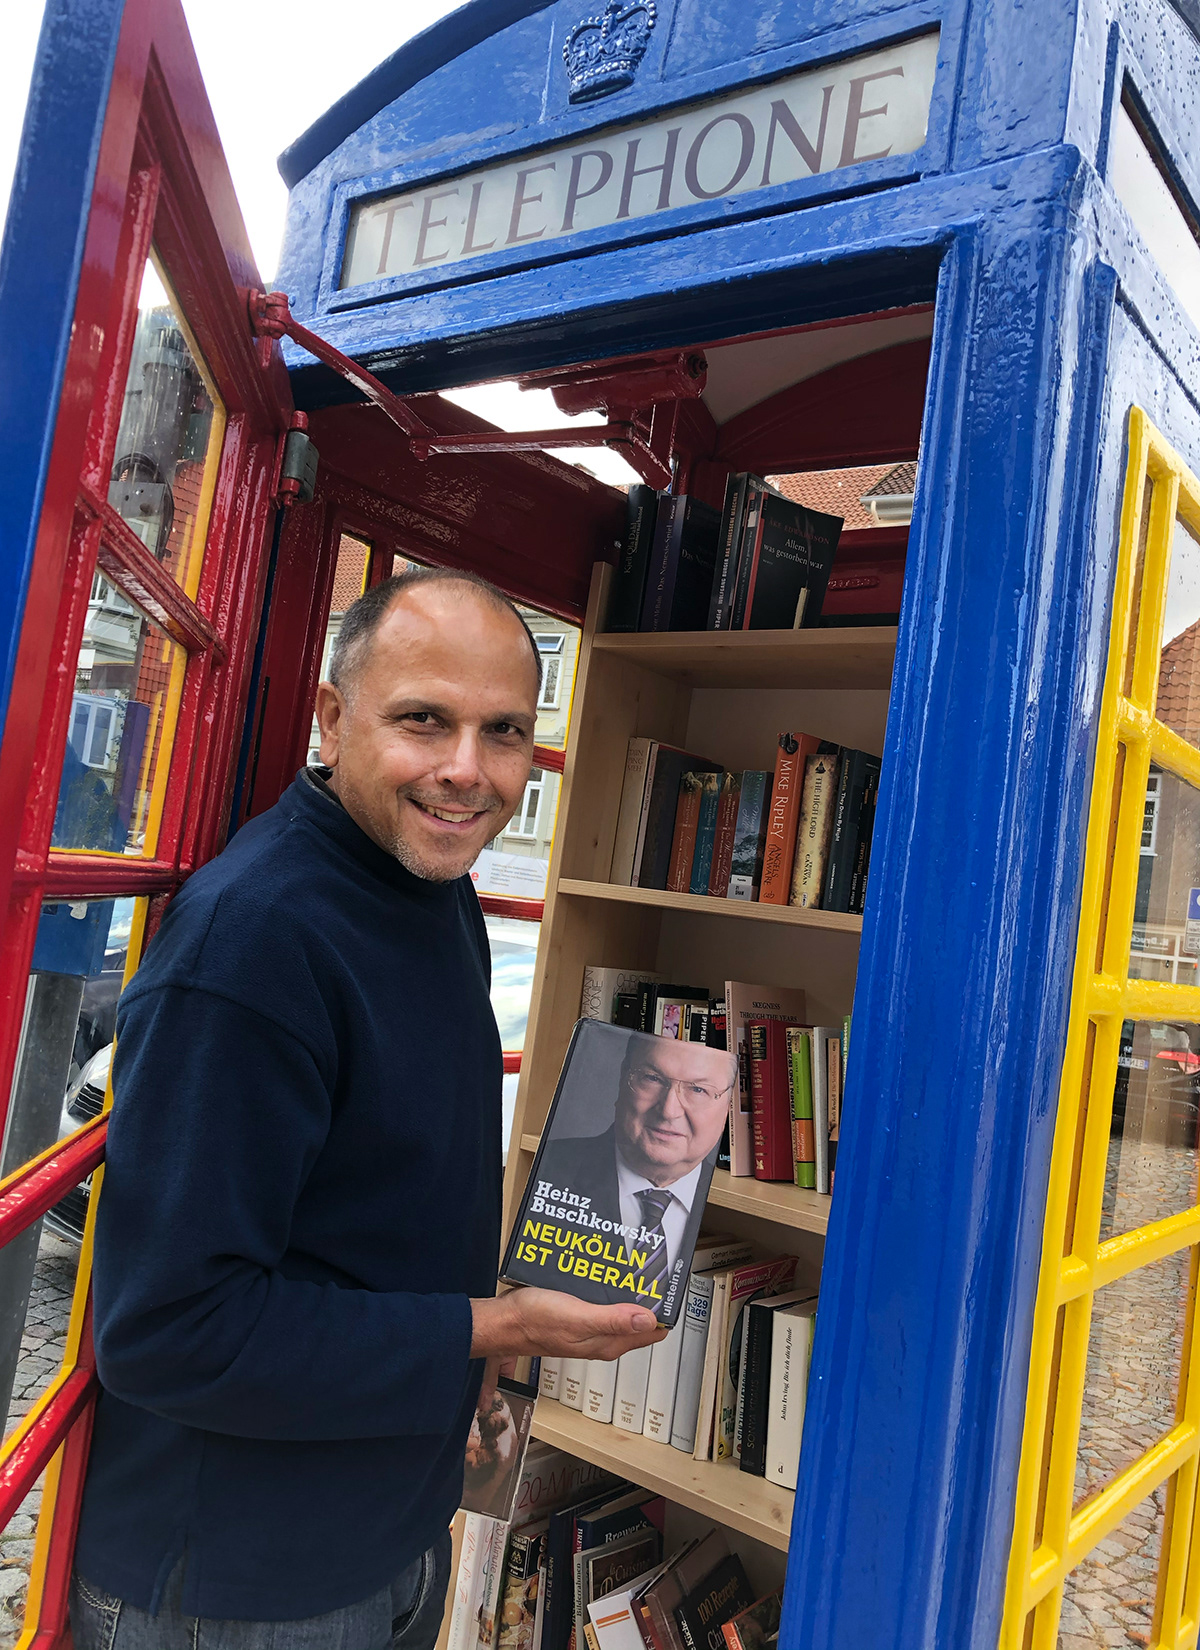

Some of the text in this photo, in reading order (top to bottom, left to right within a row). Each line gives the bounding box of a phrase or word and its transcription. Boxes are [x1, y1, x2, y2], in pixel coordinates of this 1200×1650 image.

[372, 67, 905, 276] TELEPHONE
[763, 543, 775, 556] was
[775, 547, 808, 567] gestorben
[809, 559, 824, 570] war
[785, 537, 807, 554] Allem,
[657, 576, 666, 592] Das
[714, 609, 722, 629] PIPER
[768, 758, 793, 840] MIKE RIPLEY
[811, 793, 821, 816] HIGH
[808, 815, 818, 839] LORD
[763, 843, 776, 886] UNAWARE
[771, 843, 782, 879] ANGELS
[802, 853, 811, 886] CANAVAN
[640, 992, 648, 1017] Canem
[739, 1011, 798, 1023] THROUGH THE YEARS
[752, 1001, 781, 1010] SKEGNESS
[700, 1016, 708, 1042] PIPER
[534, 1180, 592, 1209] Heinz
[530, 1196, 665, 1250] Buschkowsky
[522, 1219, 647, 1270] NEUKÖLLN
[516, 1241, 663, 1300] IST ÜBERALL
[663, 1274, 680, 1317] ullstein
[687, 1302, 707, 1317] Tage
[692, 1297, 708, 1309] 329
[781, 1383, 789, 1404] Irving
[785, 1326, 793, 1345] finde
[745, 1414, 755, 1450] SONYA
[518, 1462, 611, 1509] 20-Minute
[604, 1520, 648, 1544] Brewer's
[483, 1521, 505, 1609] 20-Minute Cookbook
[696, 1575, 741, 1626] 100 Rezepte
[680, 1617, 694, 1646] Küche
